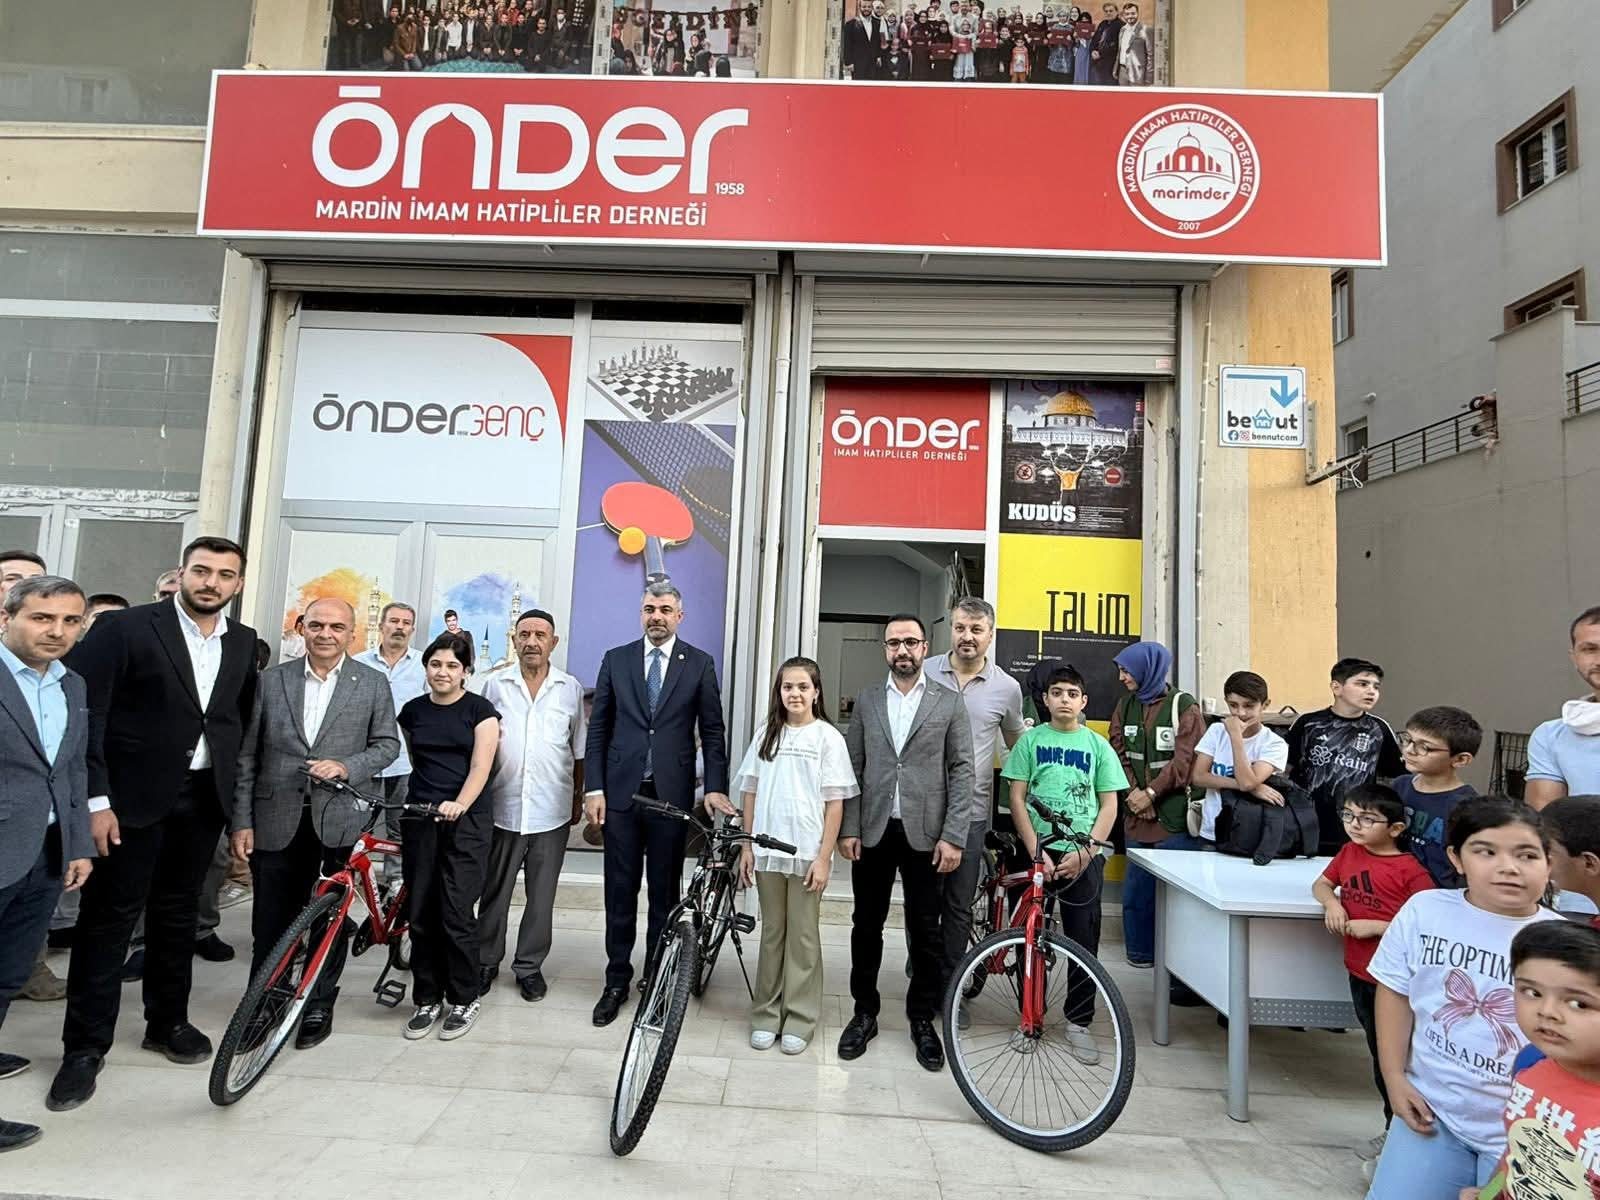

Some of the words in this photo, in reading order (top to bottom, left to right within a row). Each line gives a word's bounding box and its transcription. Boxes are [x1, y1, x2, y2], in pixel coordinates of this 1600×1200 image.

[715, 182, 745, 195] 1958
[1152, 186, 1231, 201] marimder
[316, 195, 402, 220] MARDİN
[409, 196, 469, 222] İMAM
[477, 198, 601, 224] HATİPLİLER
[609, 202, 707, 227] DERNEĞİ
[1177, 221, 1201, 231] 2007
[1008, 501, 1077, 523] KUDÜS
[1334, 753, 1368, 772] Rain
[1420, 934, 1448, 966] THE
[1425, 1026, 1444, 1049] LIFE
[1444, 1040, 1457, 1056] IS
[1459, 1048, 1470, 1064] A
[1474, 1053, 1513, 1078] DRE
